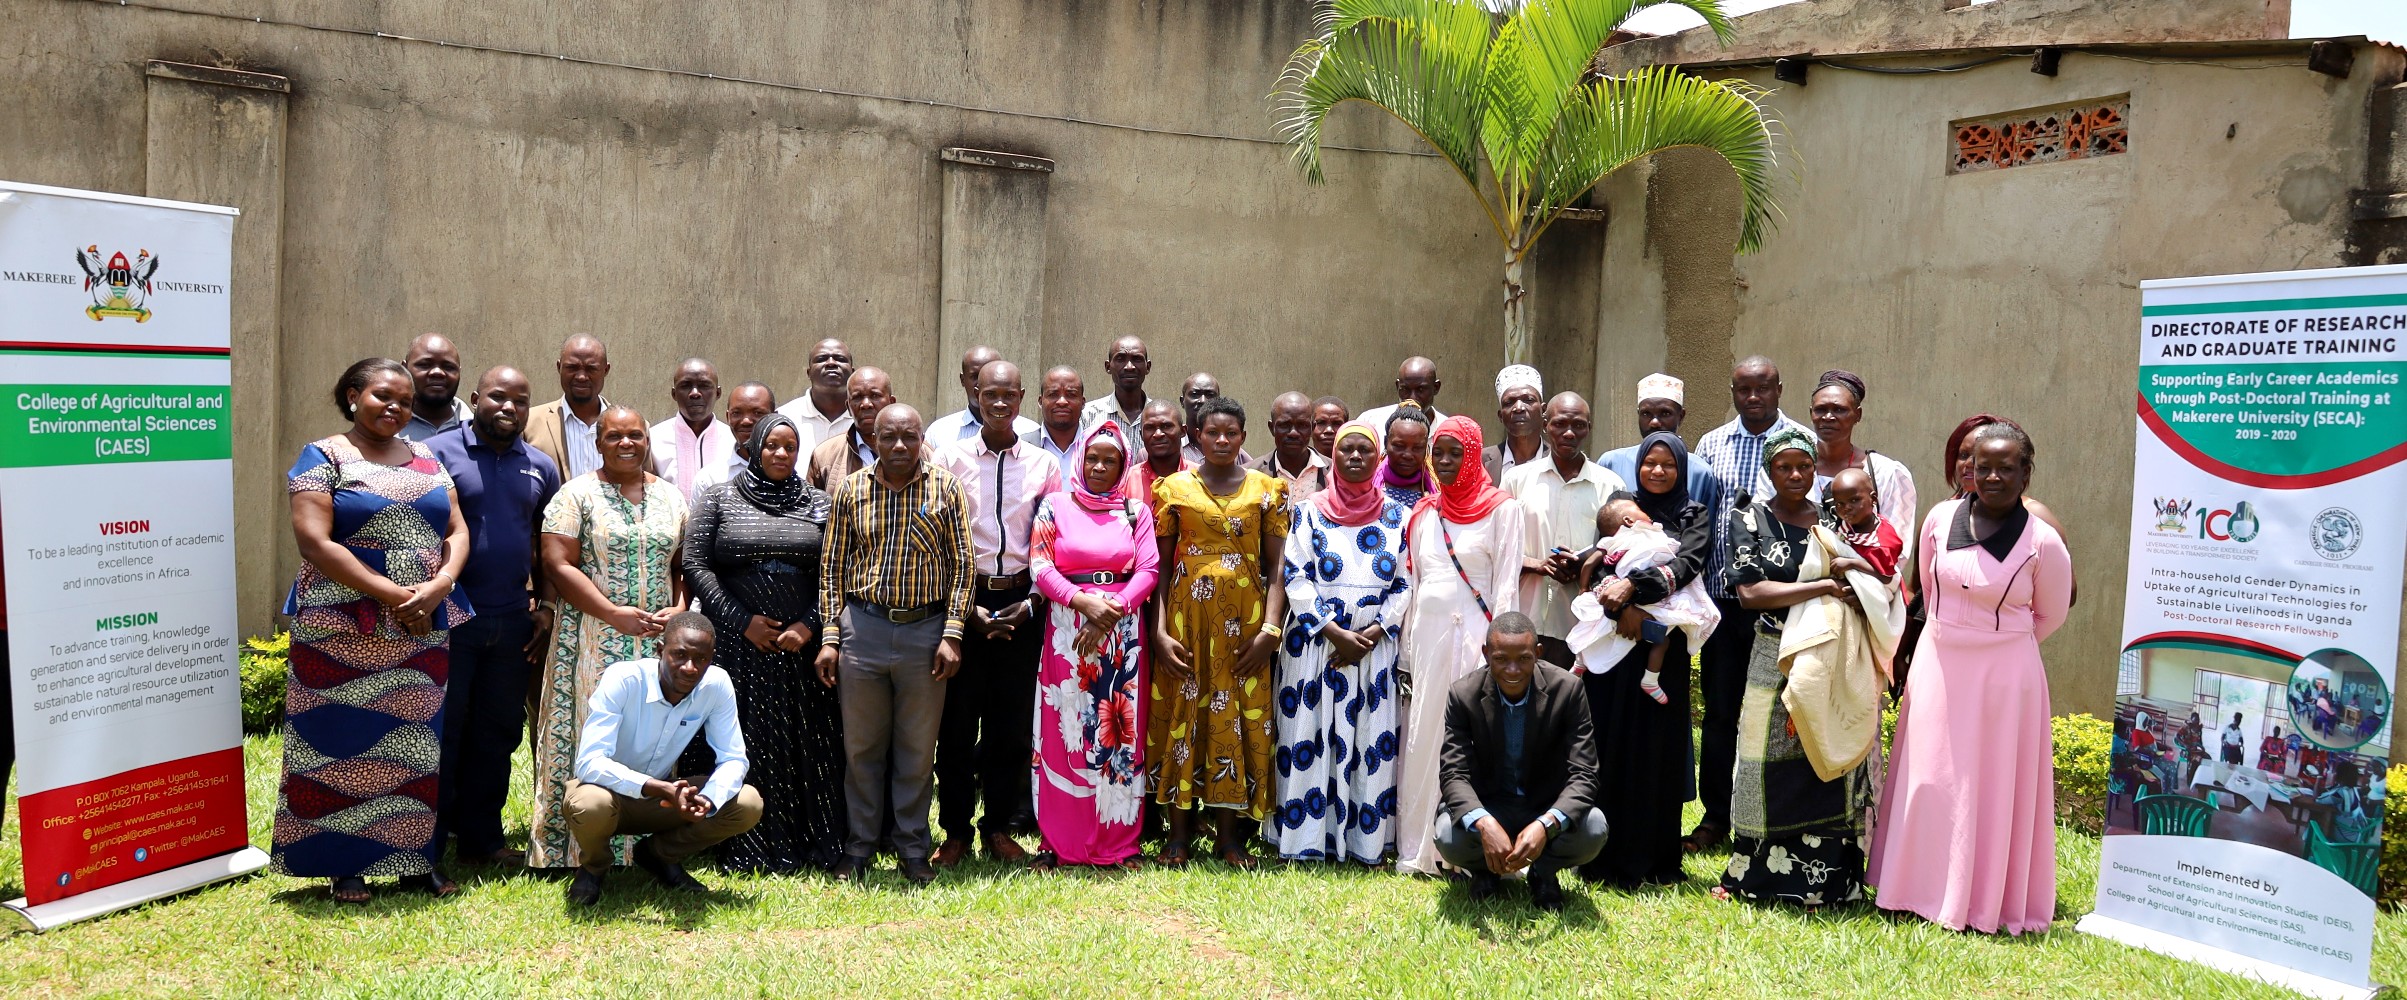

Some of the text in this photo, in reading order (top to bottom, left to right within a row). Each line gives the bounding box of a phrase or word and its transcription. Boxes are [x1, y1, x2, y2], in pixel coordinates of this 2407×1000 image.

[3, 271, 225, 295] MAKERERE UNIVERSITY
[2151, 315, 2406, 338] DIRECTORATE OF RESEARCH
[2161, 338, 2396, 358] AND GRADUATE TRAINING
[2151, 370, 2399, 389] Supporting Early Career Academics
[17, 393, 223, 414] College of Agricultural and
[2155, 391, 2391, 408] through Post-Doctoral Training at
[29, 416, 217, 434] Environmental Sciences
[2172, 410, 2366, 428] Makerere University (SECA):
[95, 436, 150, 458] (CAES)
[2235, 429, 2261, 441] 2019
[2271, 429, 2297, 441] 2020
[99, 519, 150, 535] VISION
[28, 533, 225, 561] To be a leading institution of academic
[2185, 551, 2231, 560] TRANSFORMED
[2232, 554, 2258, 562] SOCIETY
[2191, 544, 2210, 552] YEARS
[2220, 547, 2260, 556] EXCELLENCE
[97, 555, 154, 570] excellence
[63, 567, 192, 591] and innovations in Africa.
[2151, 567, 2360, 597] Intra-household Gender Dynamics in
[2144, 581, 2368, 612] Uptake of Agricultural Technologies for
[2156, 595, 2352, 627] Sustainable Livelihoods in Uganda
[96, 612, 158, 632] MISSION
[2163, 610, 2339, 640] Post-Doctoral Research Fellowship
[50, 624, 211, 657] To advance training, knowledge
[30, 637, 231, 681] generation and service delivery in order
[37, 653, 226, 693] to enhance agricultural development,
[33, 667, 230, 712] sustainable natural resource utilization
[49, 686, 215, 725] and environmental management
[42, 814, 77, 830] Office:
[143, 791, 162, 803] Fax:
[163, 774, 230, 797] +256414531641
[76, 770, 201, 807] P.O BOX 7062 Kampala, Uganda,
[93, 798, 206, 837] Website: www.caes.mak.ac.ug
[99, 815, 197, 852] principal@caes.mak.ac.ug
[75, 856, 118, 880] @MakCAES
[149, 840, 180, 856] Twitter:
[180, 826, 226, 848] @MakCAES
[2112, 861, 2161, 883] Department
[2163, 873, 2173, 883] of
[2173, 875, 2215, 896] Extension
[2216, 887, 2233, 899] and
[2234, 890, 2283, 912] Innovation
[2284, 905, 2319, 922] Studies
[2177, 860, 2279, 896] Implemented by
[2147, 884, 2175, 900] School
[2176, 891, 2185, 901] of
[2186, 895, 2238, 914] Agricultural
[2239, 907, 2279, 926] Sciences
[2106, 888, 2353, 963] College of Agricultural and Environmental Science (CAES)
